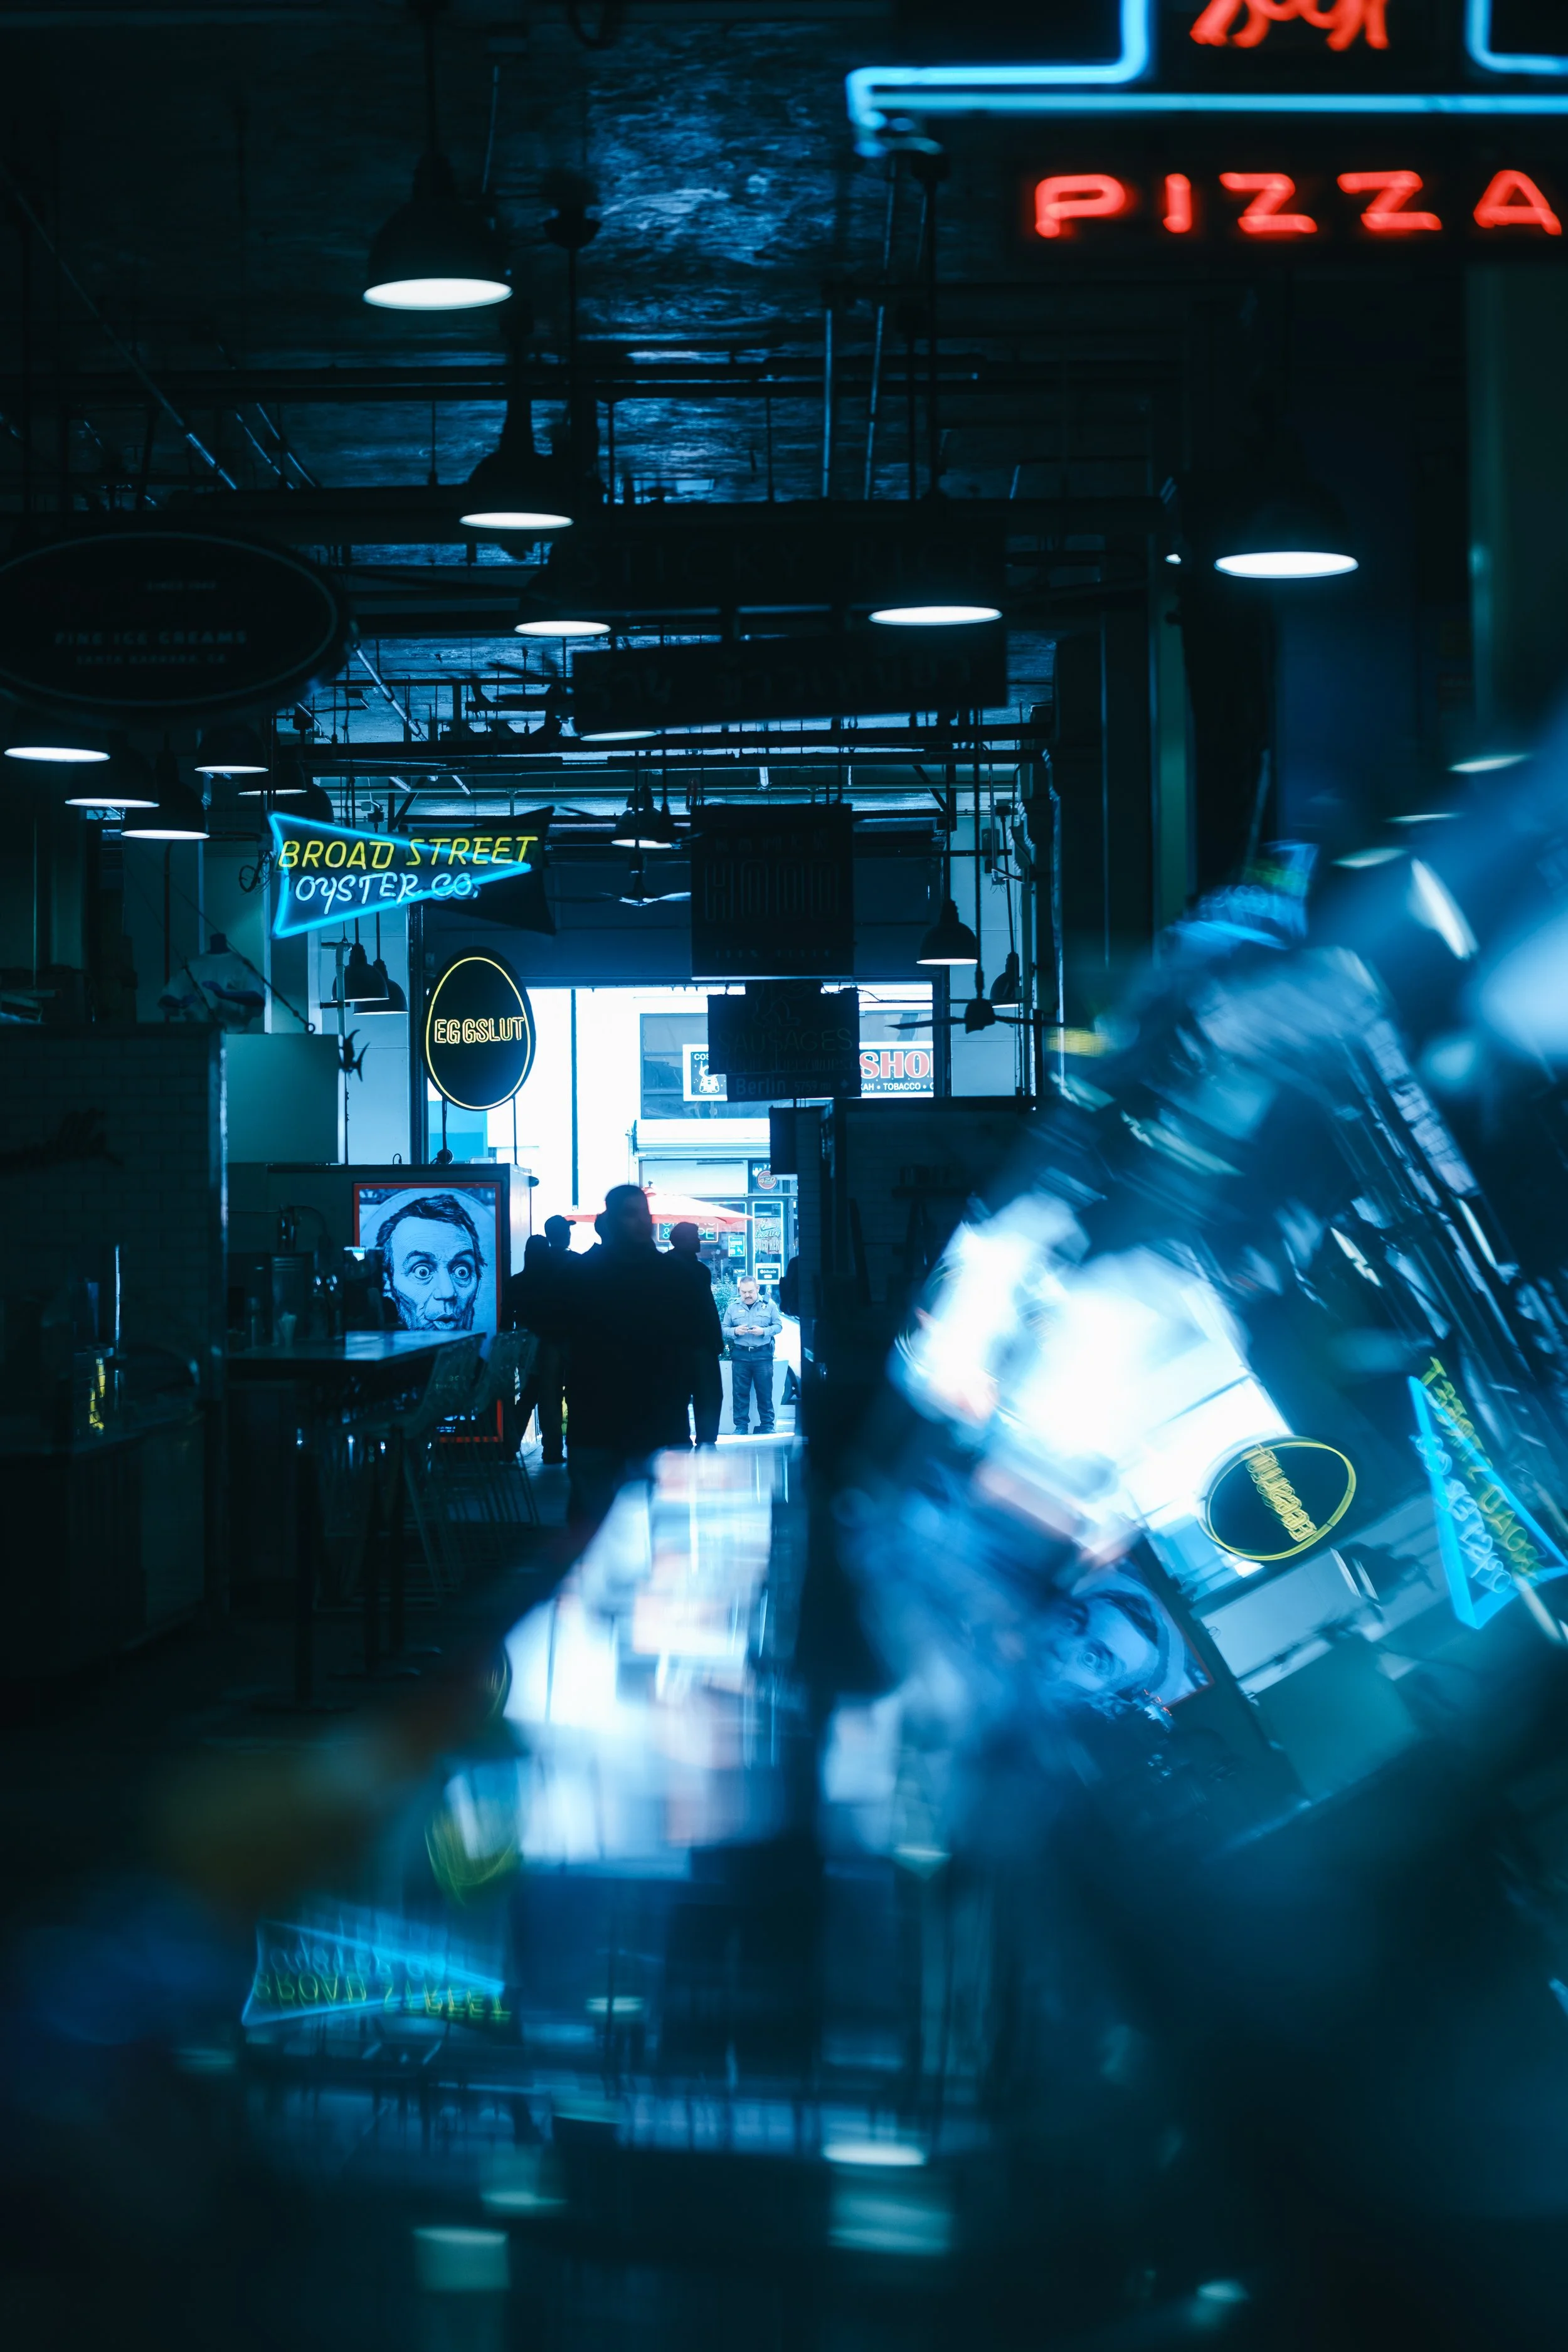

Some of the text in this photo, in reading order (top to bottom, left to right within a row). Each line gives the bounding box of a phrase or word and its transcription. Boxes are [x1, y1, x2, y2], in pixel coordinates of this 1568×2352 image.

[1034, 169, 1562, 238] PIZZA
[278, 835, 539, 870] BROAD STREET
[295, 872, 422, 914] OYSTER
[434, 1017, 525, 1044] EGGSLUT
[717, 1027, 852, 1054] SAUSAGES
[736, 1076, 786, 1096] Berlin
[883, 1083, 921, 1091] TOBACCO
[662, 1227, 670, 1239] &
